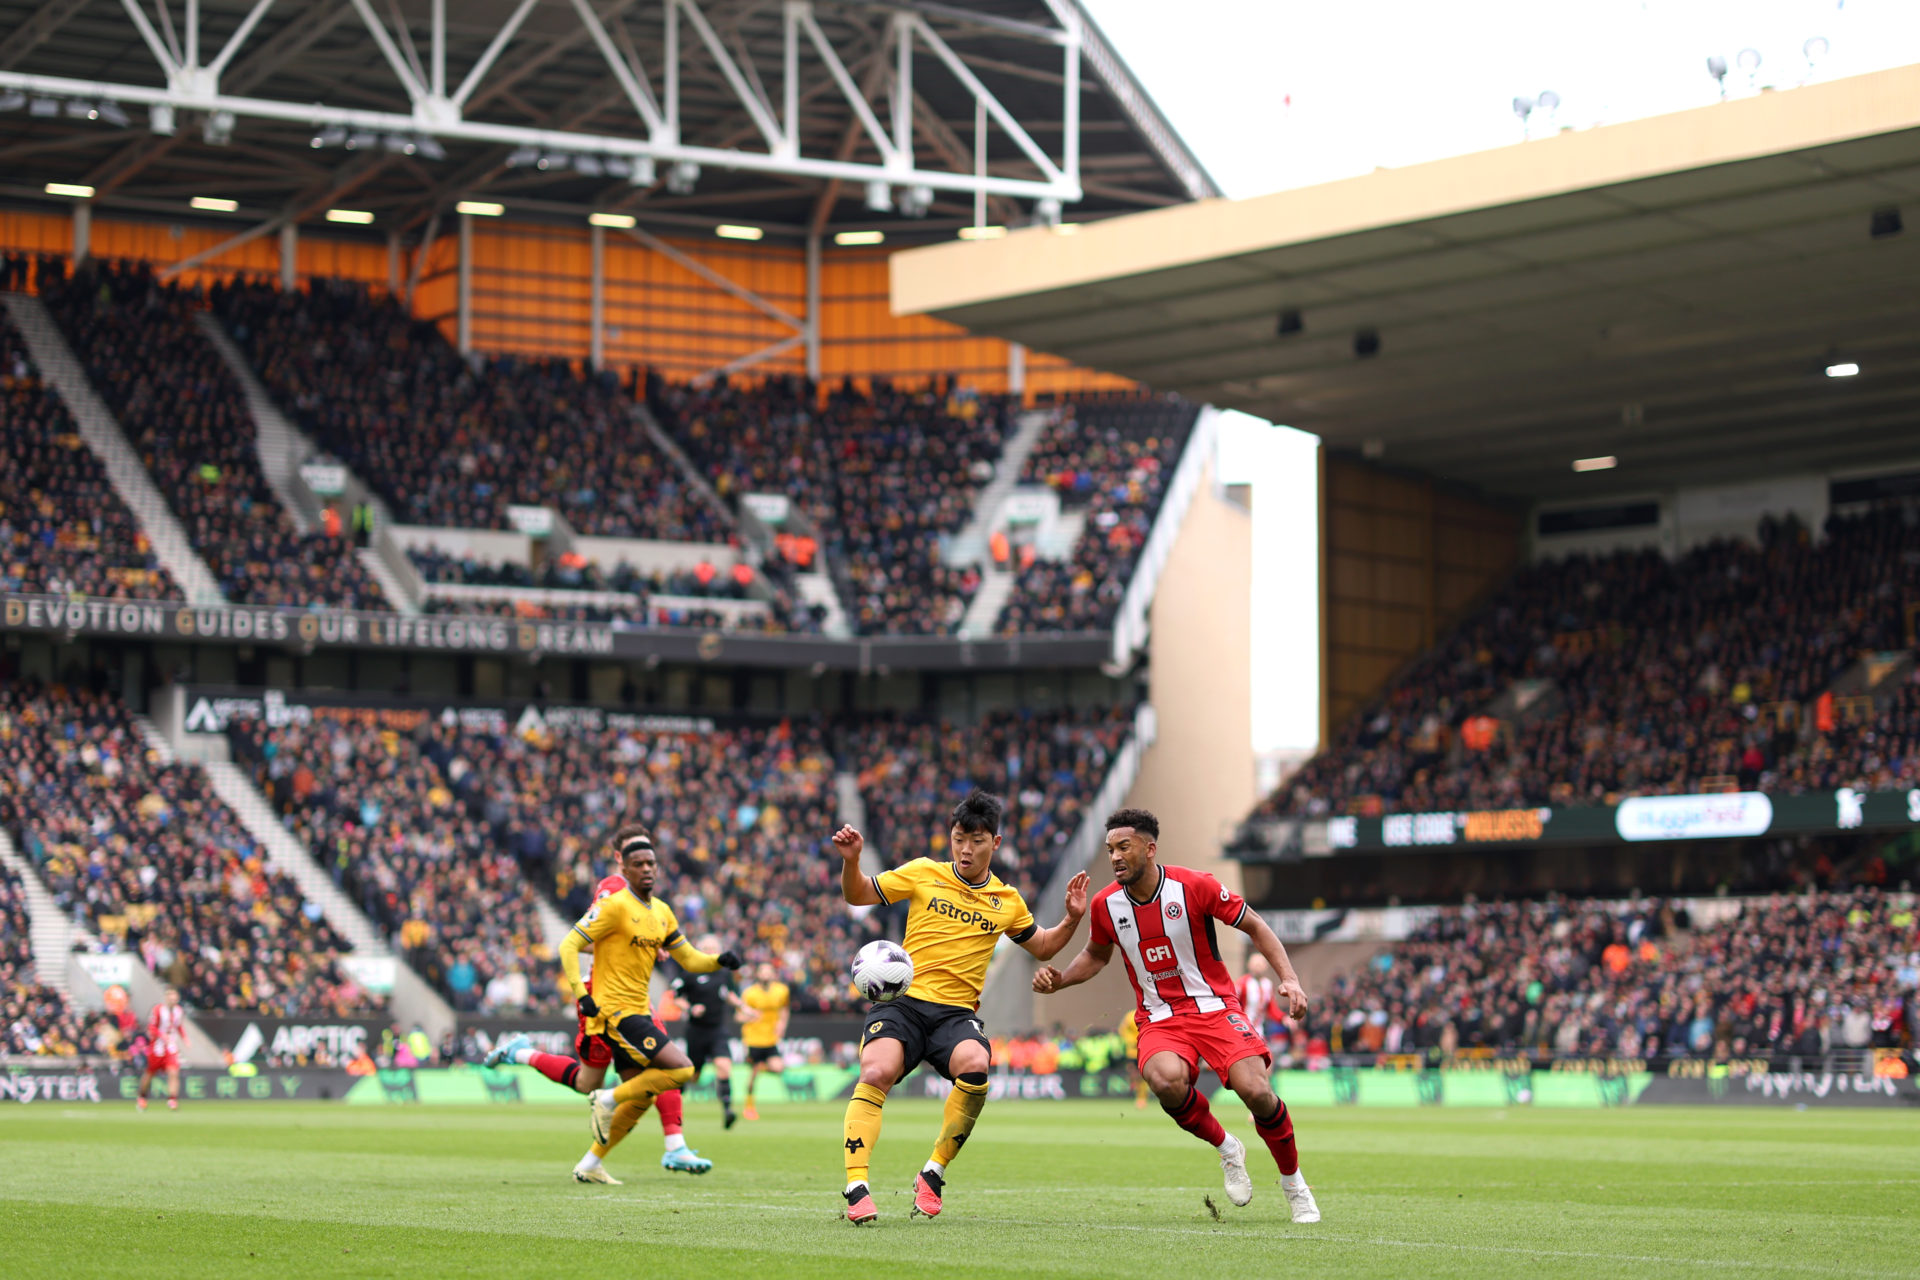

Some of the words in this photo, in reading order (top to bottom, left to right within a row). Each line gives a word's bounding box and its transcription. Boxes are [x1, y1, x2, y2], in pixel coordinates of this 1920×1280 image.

[5, 600, 164, 634] DEVOTION
[175, 607, 288, 640] GUIDES
[298, 612, 360, 643] OUR
[369, 616, 509, 650] LIFELONG
[518, 623, 615, 654] DREAM
[927, 897, 998, 934] AstroPay
[1145, 945, 1172, 963] CFI
[1226, 1013, 1249, 1031] 5
[271, 1025, 368, 1056] ARCTIC
